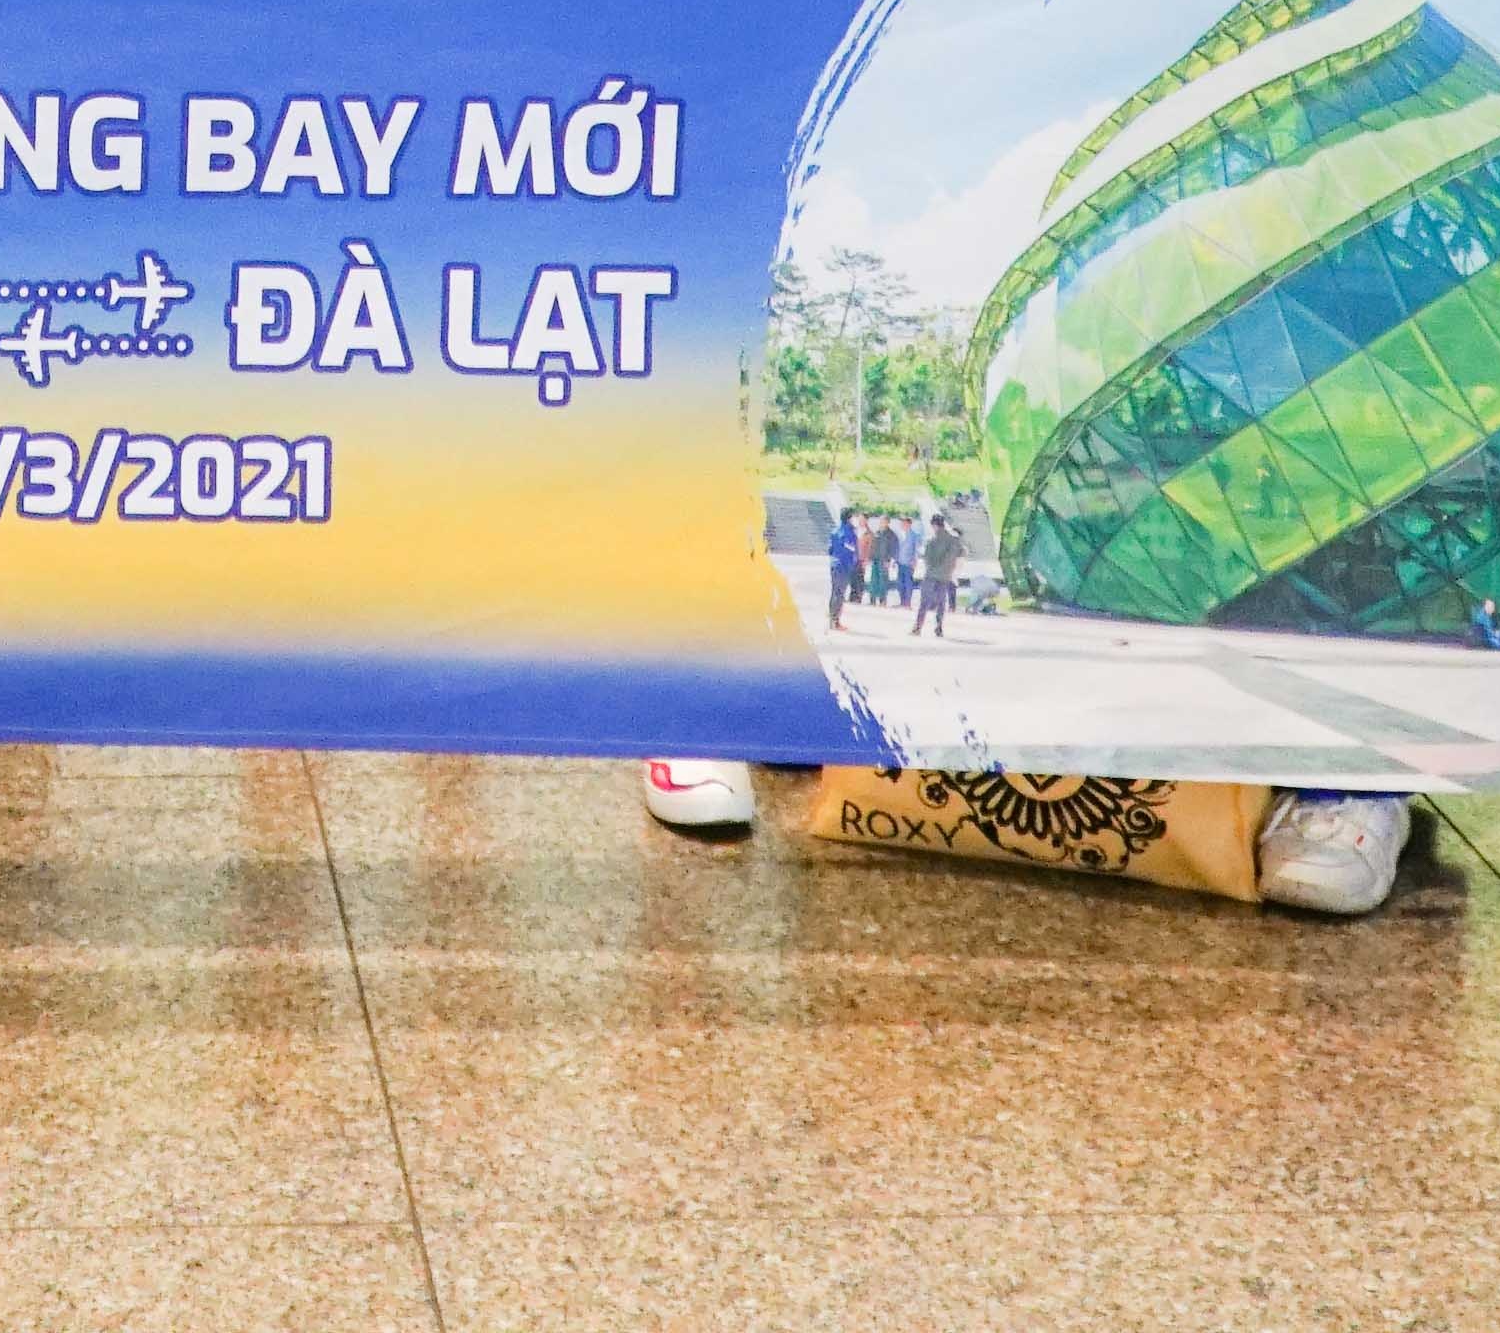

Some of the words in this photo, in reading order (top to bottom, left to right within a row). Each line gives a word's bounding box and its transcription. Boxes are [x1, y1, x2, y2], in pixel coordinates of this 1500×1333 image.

[182, 94, 421, 197] BAY
[450, 76, 682, 198] MỚI
[230, 241, 410, 372] ĐÀ
[444, 263, 676, 407] LẠT
[840, 799, 962, 849] ROXY
